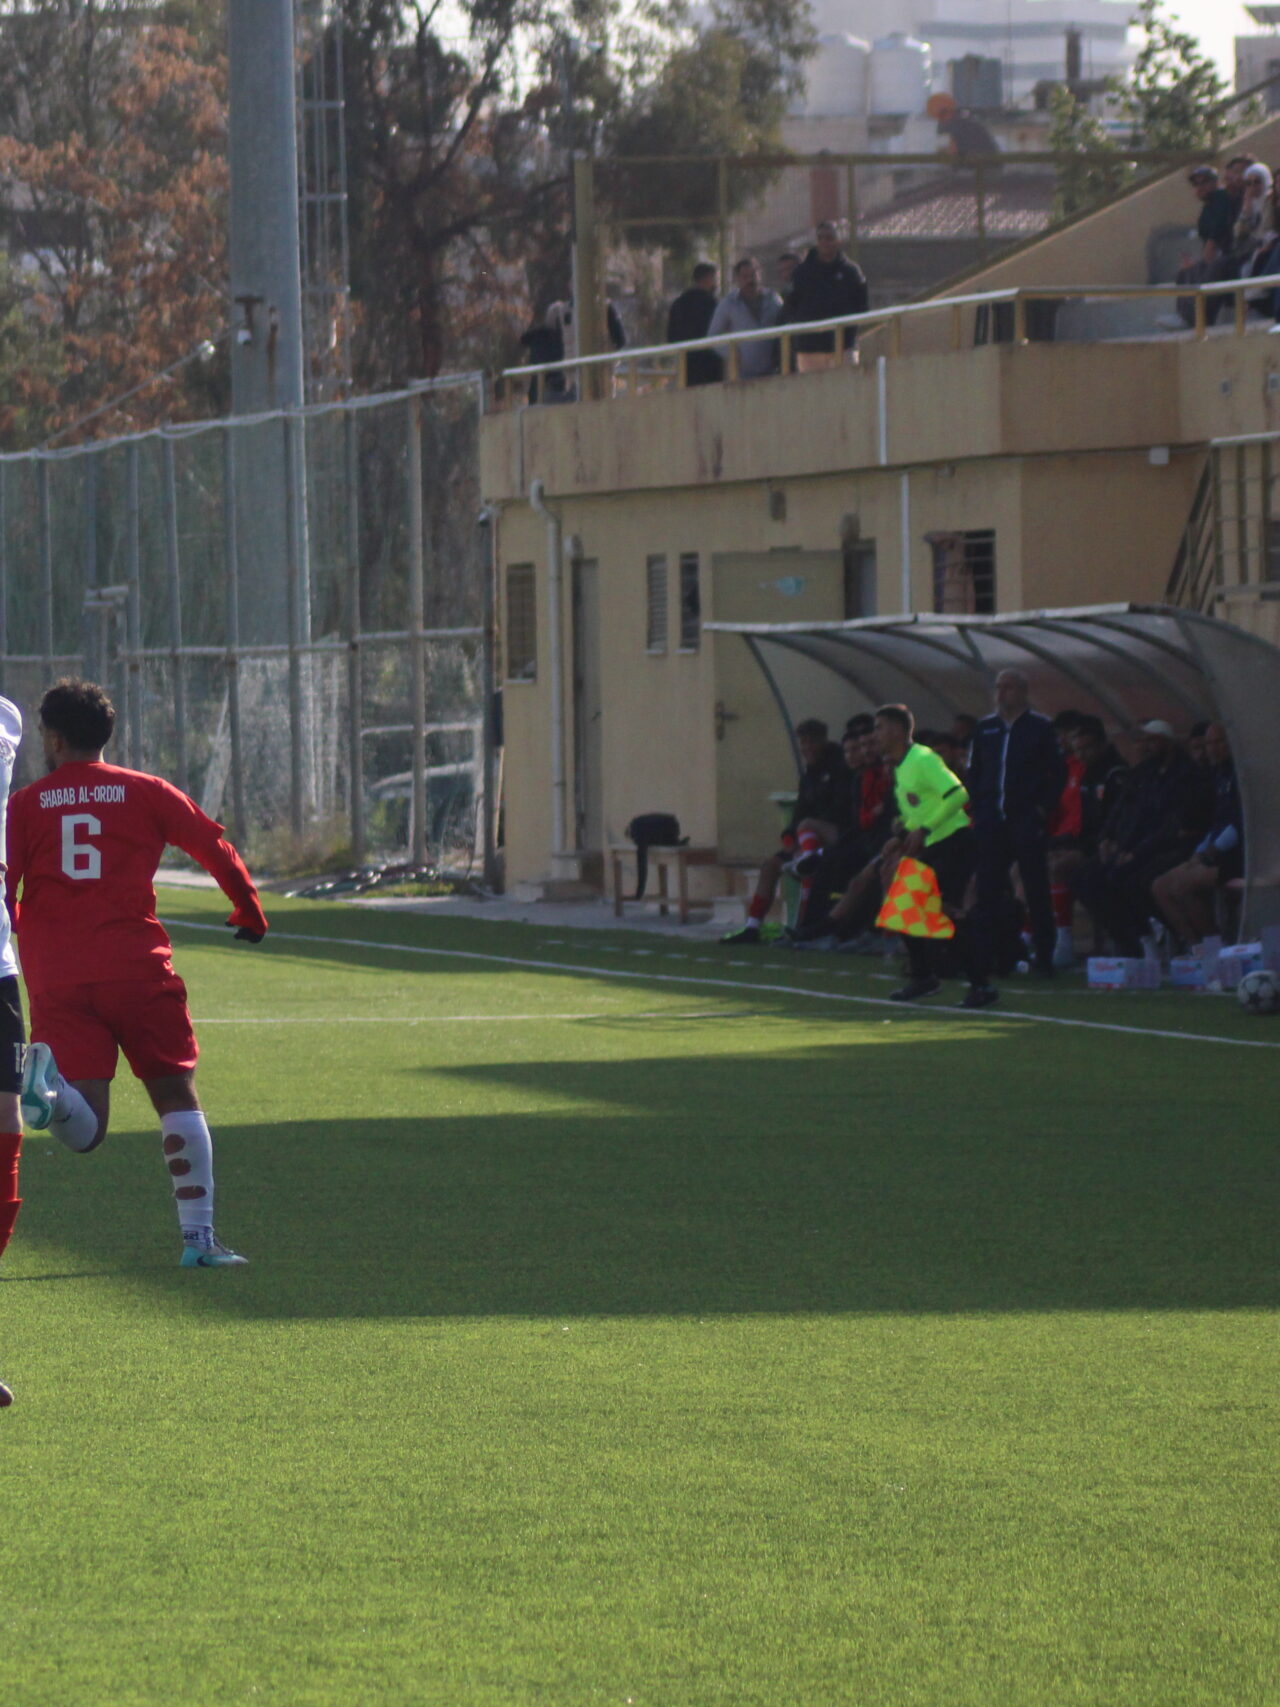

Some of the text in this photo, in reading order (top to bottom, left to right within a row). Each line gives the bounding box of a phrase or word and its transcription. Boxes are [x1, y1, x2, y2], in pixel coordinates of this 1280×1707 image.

[40, 785, 125, 808] SHABAB AL-ORDON
[62, 813, 101, 880] 6
